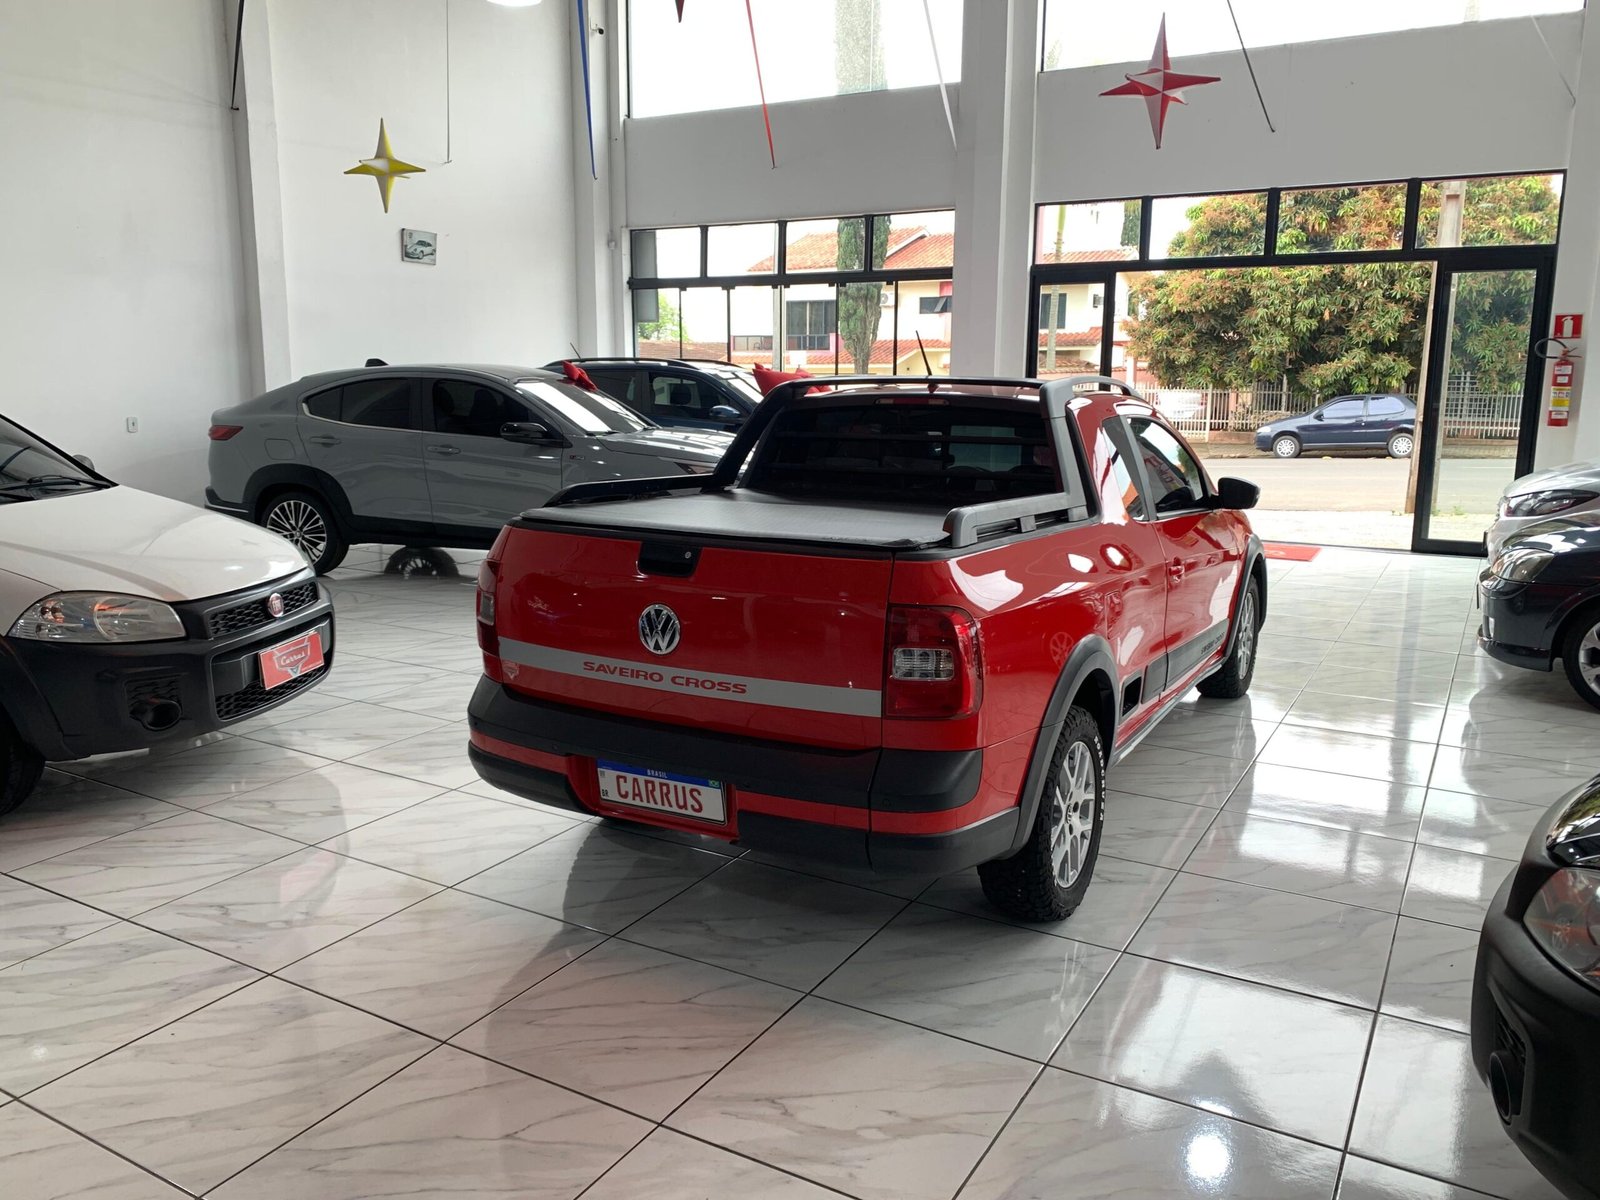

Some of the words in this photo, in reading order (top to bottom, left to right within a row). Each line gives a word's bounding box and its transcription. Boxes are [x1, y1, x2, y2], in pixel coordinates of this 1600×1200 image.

[583, 661, 664, 683] SAVEIRO
[671, 675, 747, 694] CROSS
[647, 769, 668, 779] BRASIL
[601, 788, 610, 797] BR
[616, 774, 703, 813] CARRUS
